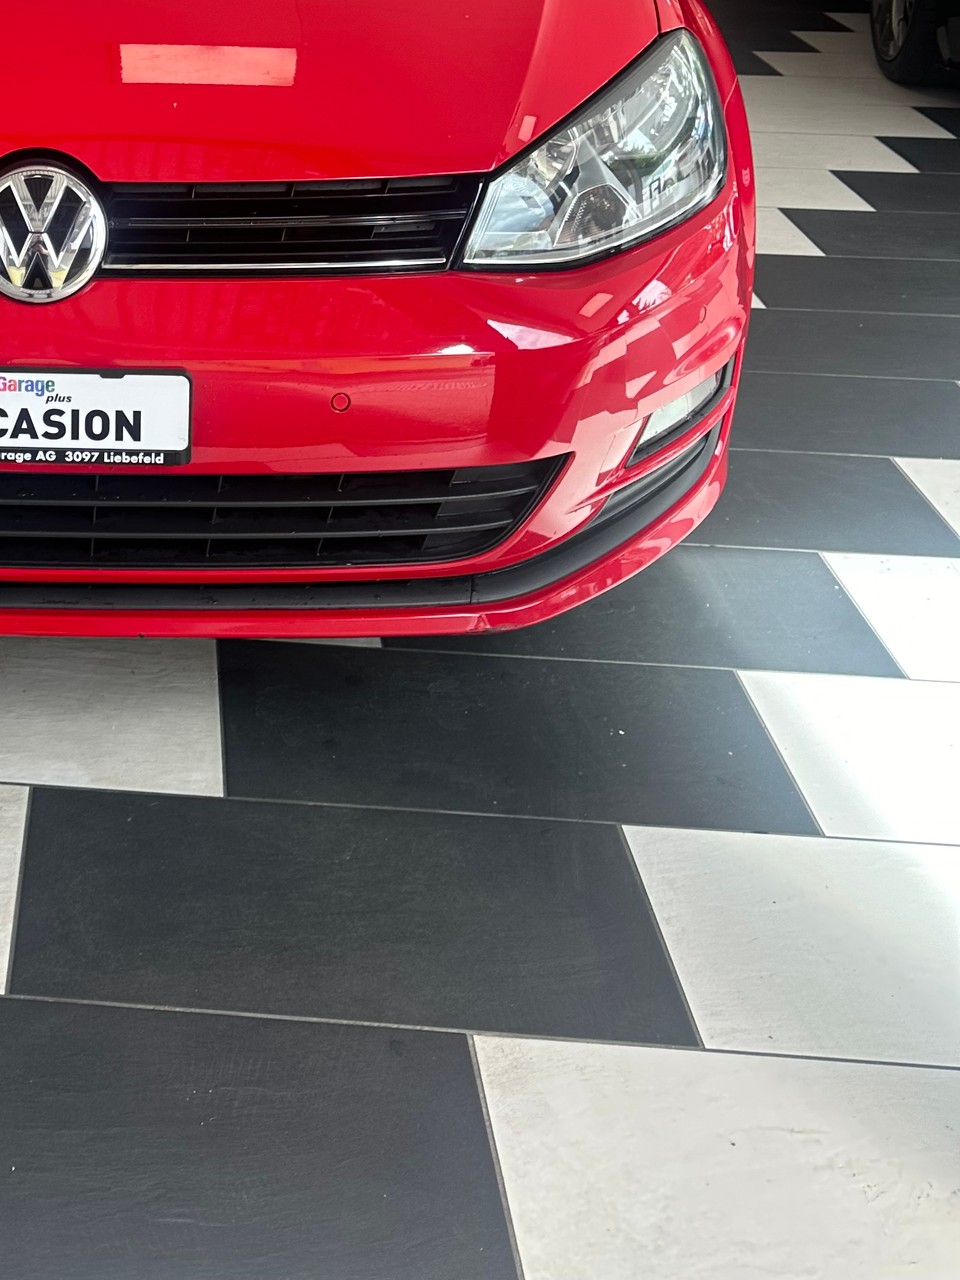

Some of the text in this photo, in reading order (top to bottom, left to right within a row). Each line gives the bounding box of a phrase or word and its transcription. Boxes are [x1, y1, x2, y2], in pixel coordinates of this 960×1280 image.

[46, 393, 72, 404] plus
[36, 451, 56, 461] AG
[65, 451, 99, 463] 3097
[104, 451, 164, 465] Liebefeld
